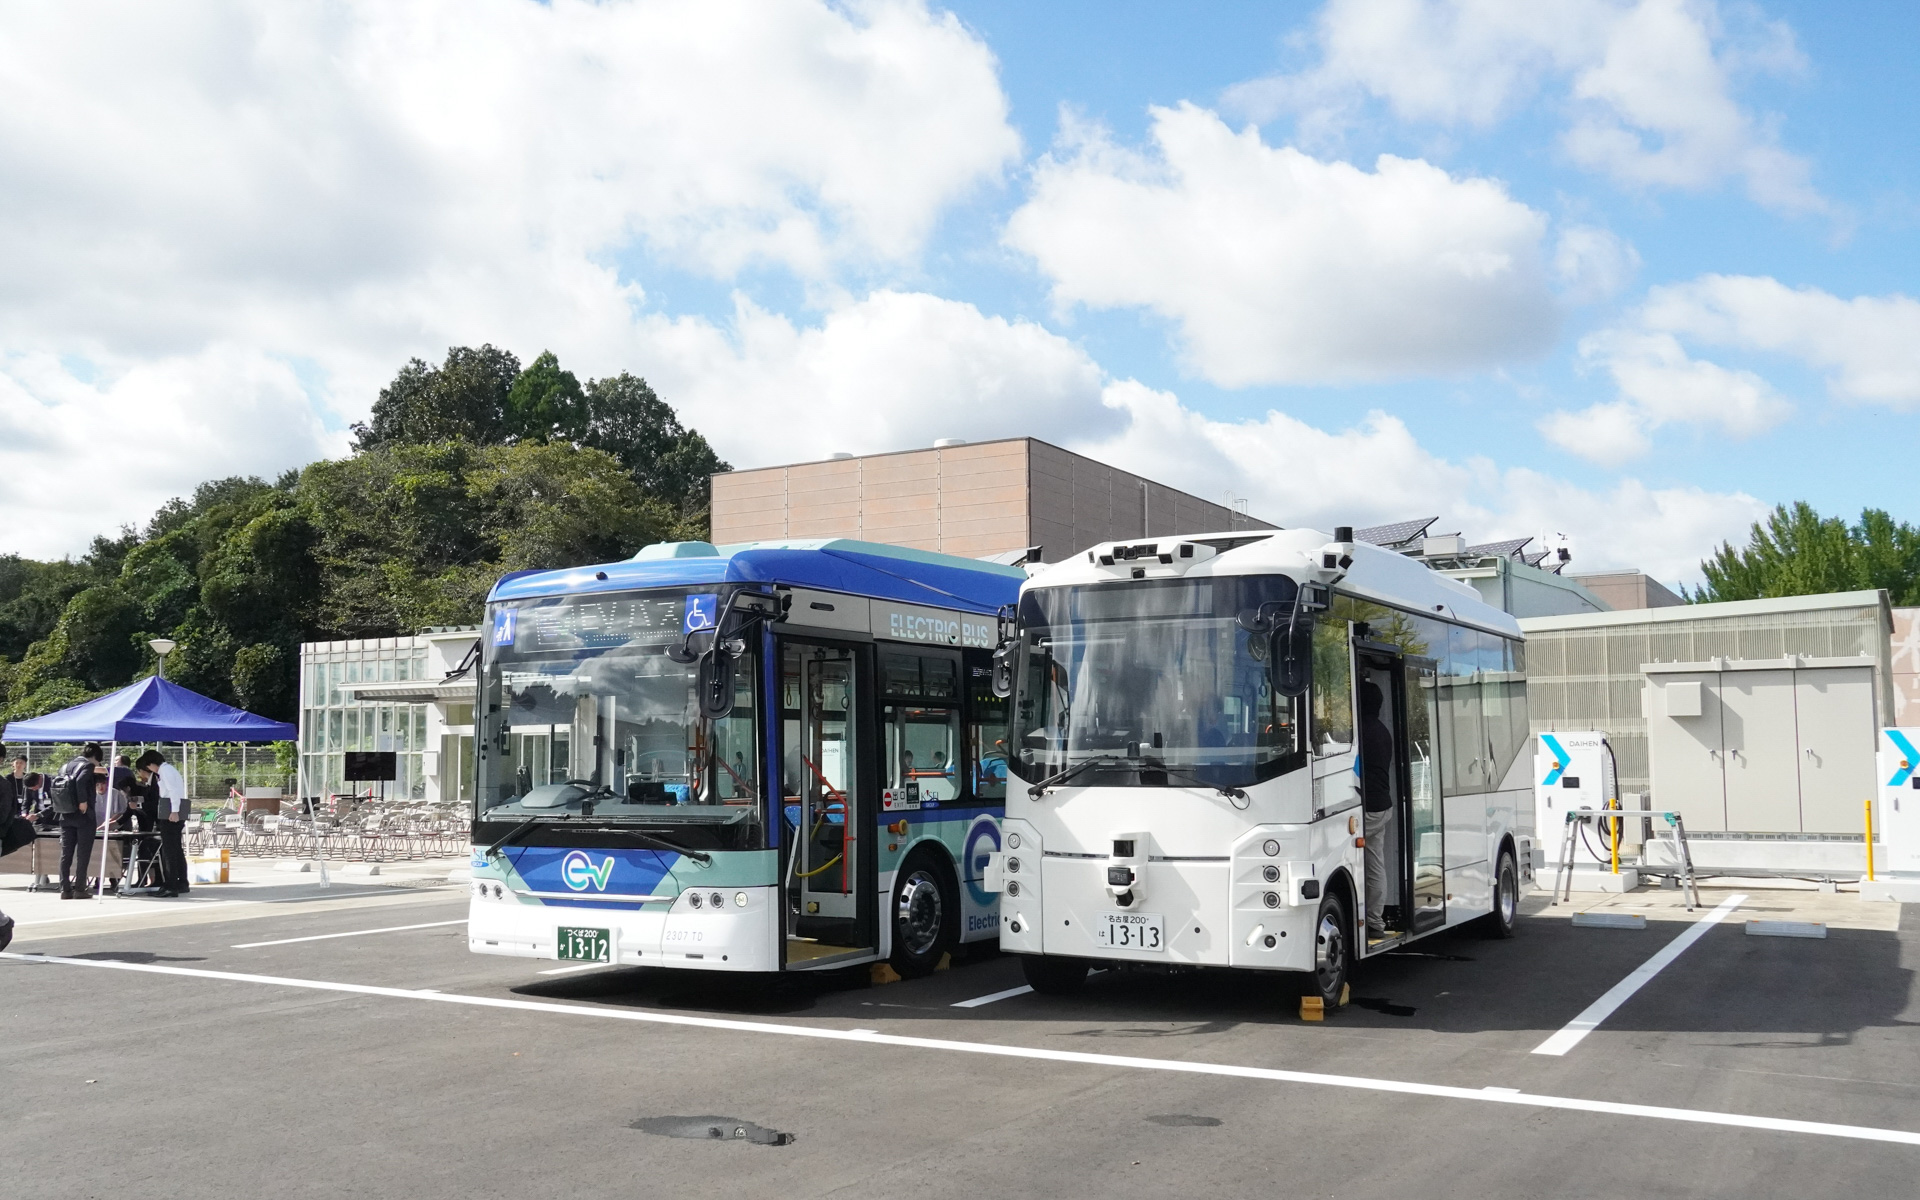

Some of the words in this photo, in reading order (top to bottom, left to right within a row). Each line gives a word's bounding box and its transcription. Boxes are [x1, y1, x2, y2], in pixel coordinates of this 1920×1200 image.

[890, 613, 958, 644] ELECTRIC
[962, 623, 989, 647] BUS
[666, 930, 688, 941] 2307
[1110, 923, 1159, 948] 13-13
[568, 936, 608, 960] 13-12
